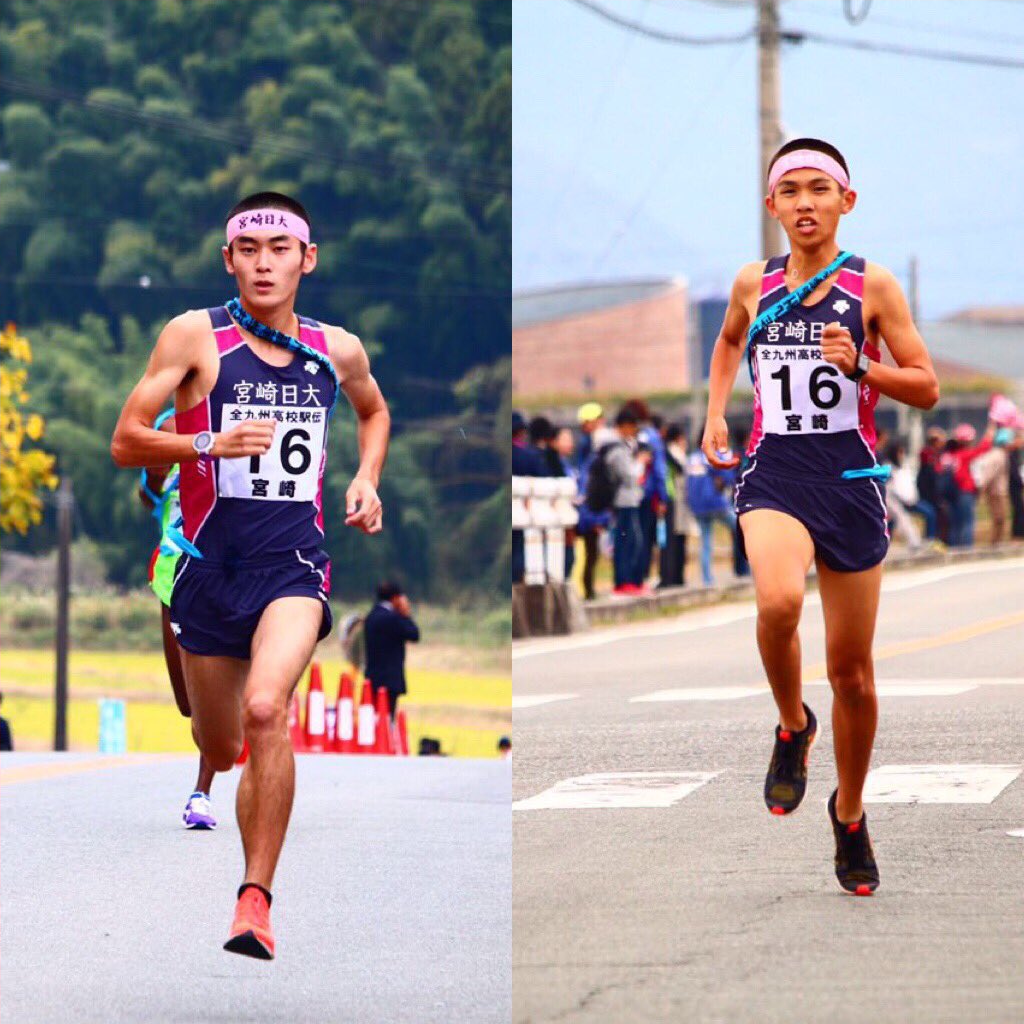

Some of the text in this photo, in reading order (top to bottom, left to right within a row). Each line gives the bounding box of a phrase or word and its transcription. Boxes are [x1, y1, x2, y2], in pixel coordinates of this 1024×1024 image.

[239, 213, 288, 229] 宮崎日大
[767, 320, 849, 343] 宮崎日
[233, 380, 321, 406] 宮崎日大
[771, 365, 842, 410] 16
[785, 414, 828, 432] 宮崎
[251, 479, 297, 498] 宮崎
